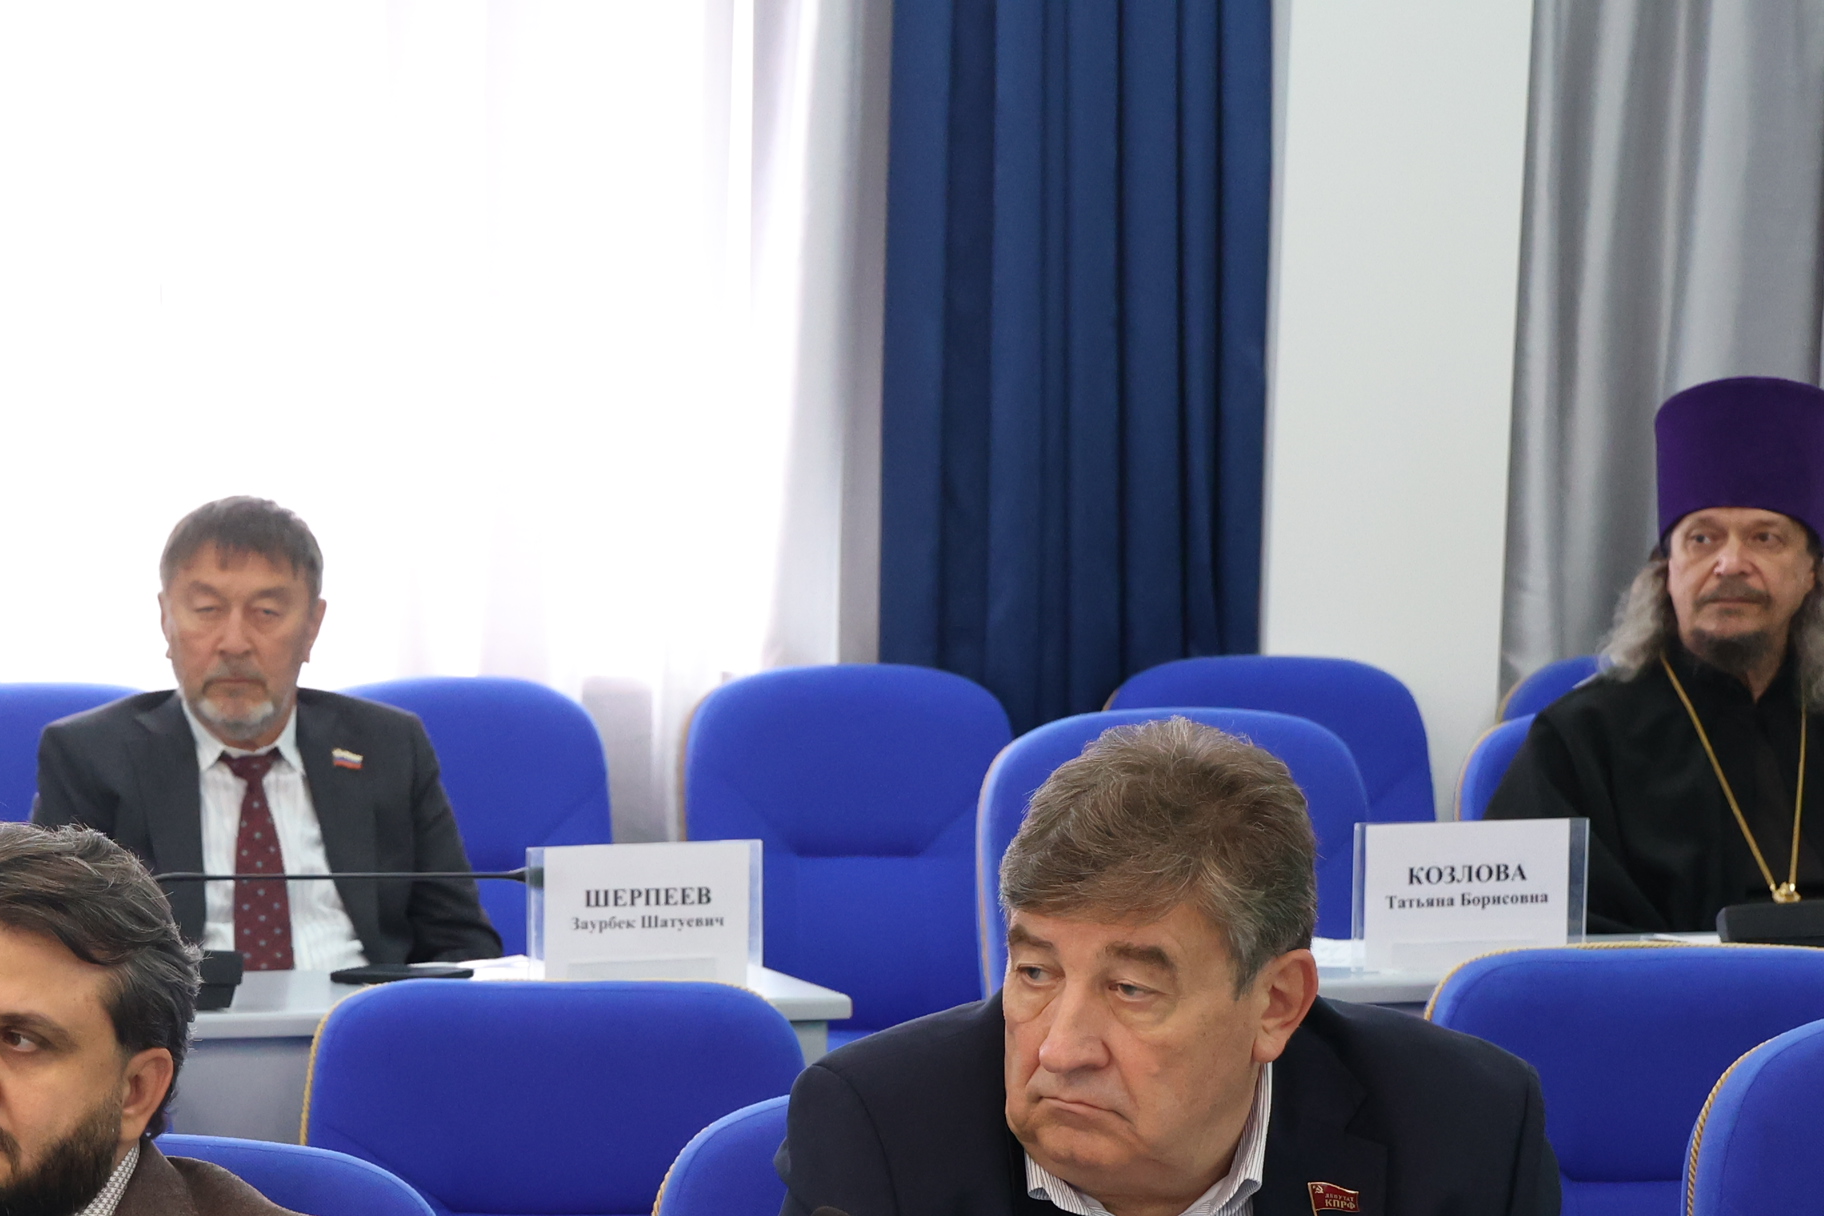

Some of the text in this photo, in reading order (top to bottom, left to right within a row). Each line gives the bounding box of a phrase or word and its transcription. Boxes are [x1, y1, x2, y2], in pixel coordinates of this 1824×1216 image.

[1408, 863, 1527, 885] КОЗЛОВА
[585, 886, 712, 908] ШЕРПЕЕВ
[1388, 892, 1549, 910] Татьяна Борисовна
[572, 914, 724, 934] Заурбек Шатуевич
[1324, 1199, 1356, 1210] КПРФ
